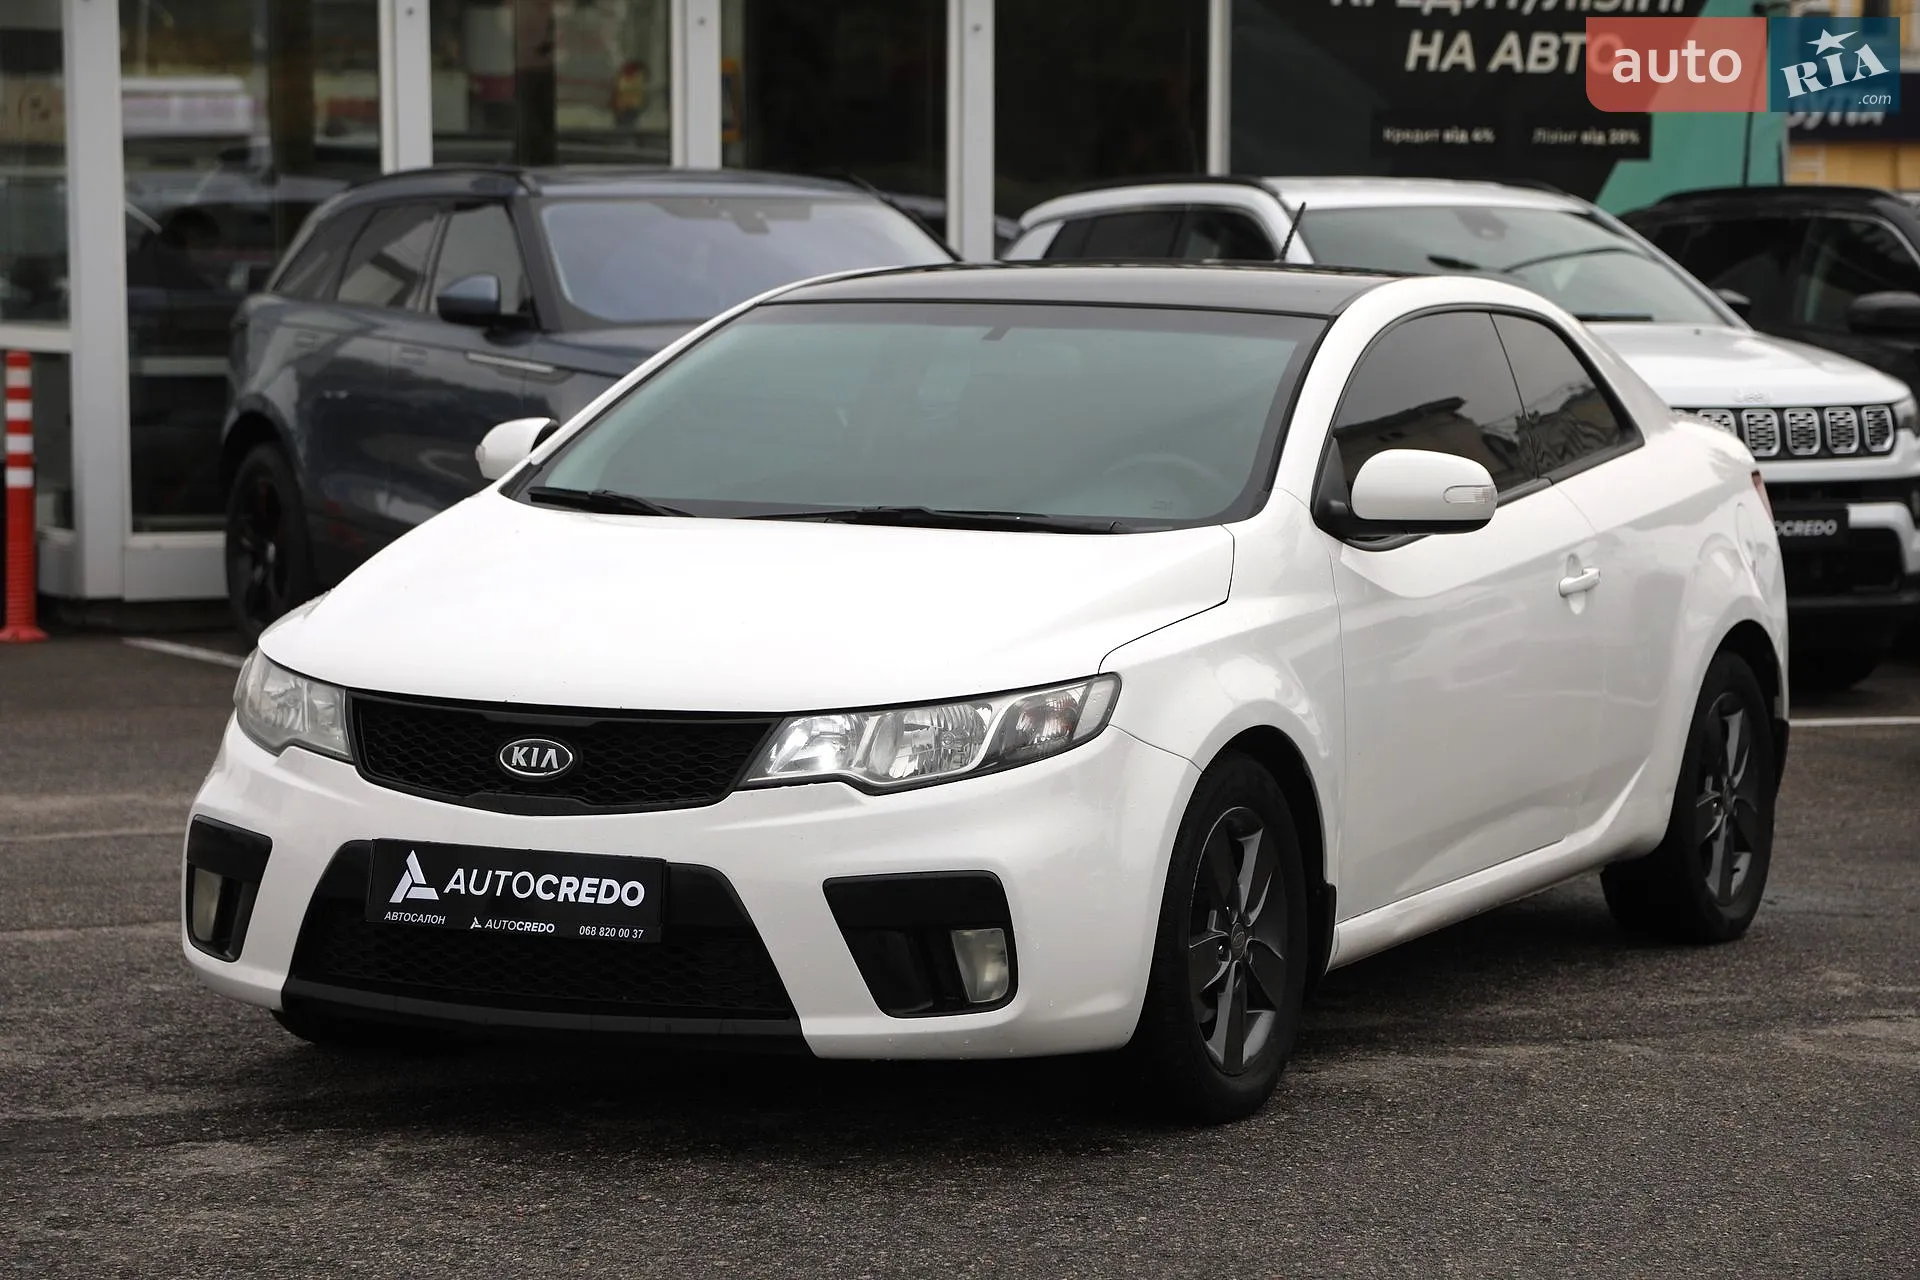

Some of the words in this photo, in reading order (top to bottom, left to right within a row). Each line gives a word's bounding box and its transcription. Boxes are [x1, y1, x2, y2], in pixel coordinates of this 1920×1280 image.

[1404, 29, 1477, 73] НА
[1487, 30, 1625, 75] АВТО
[1775, 519, 1838, 536] OCREDO
[511, 746, 559, 769] KIA
[443, 868, 646, 907] AUTOCREDO
[383, 911, 446, 925] АВТОСАЛОН
[484, 918, 556, 934] AUTOCREDO
[579, 925, 597, 936] 068
[599, 926, 617, 938] 820
[618, 928, 631, 939] 00
[632, 929, 645, 939] 37
